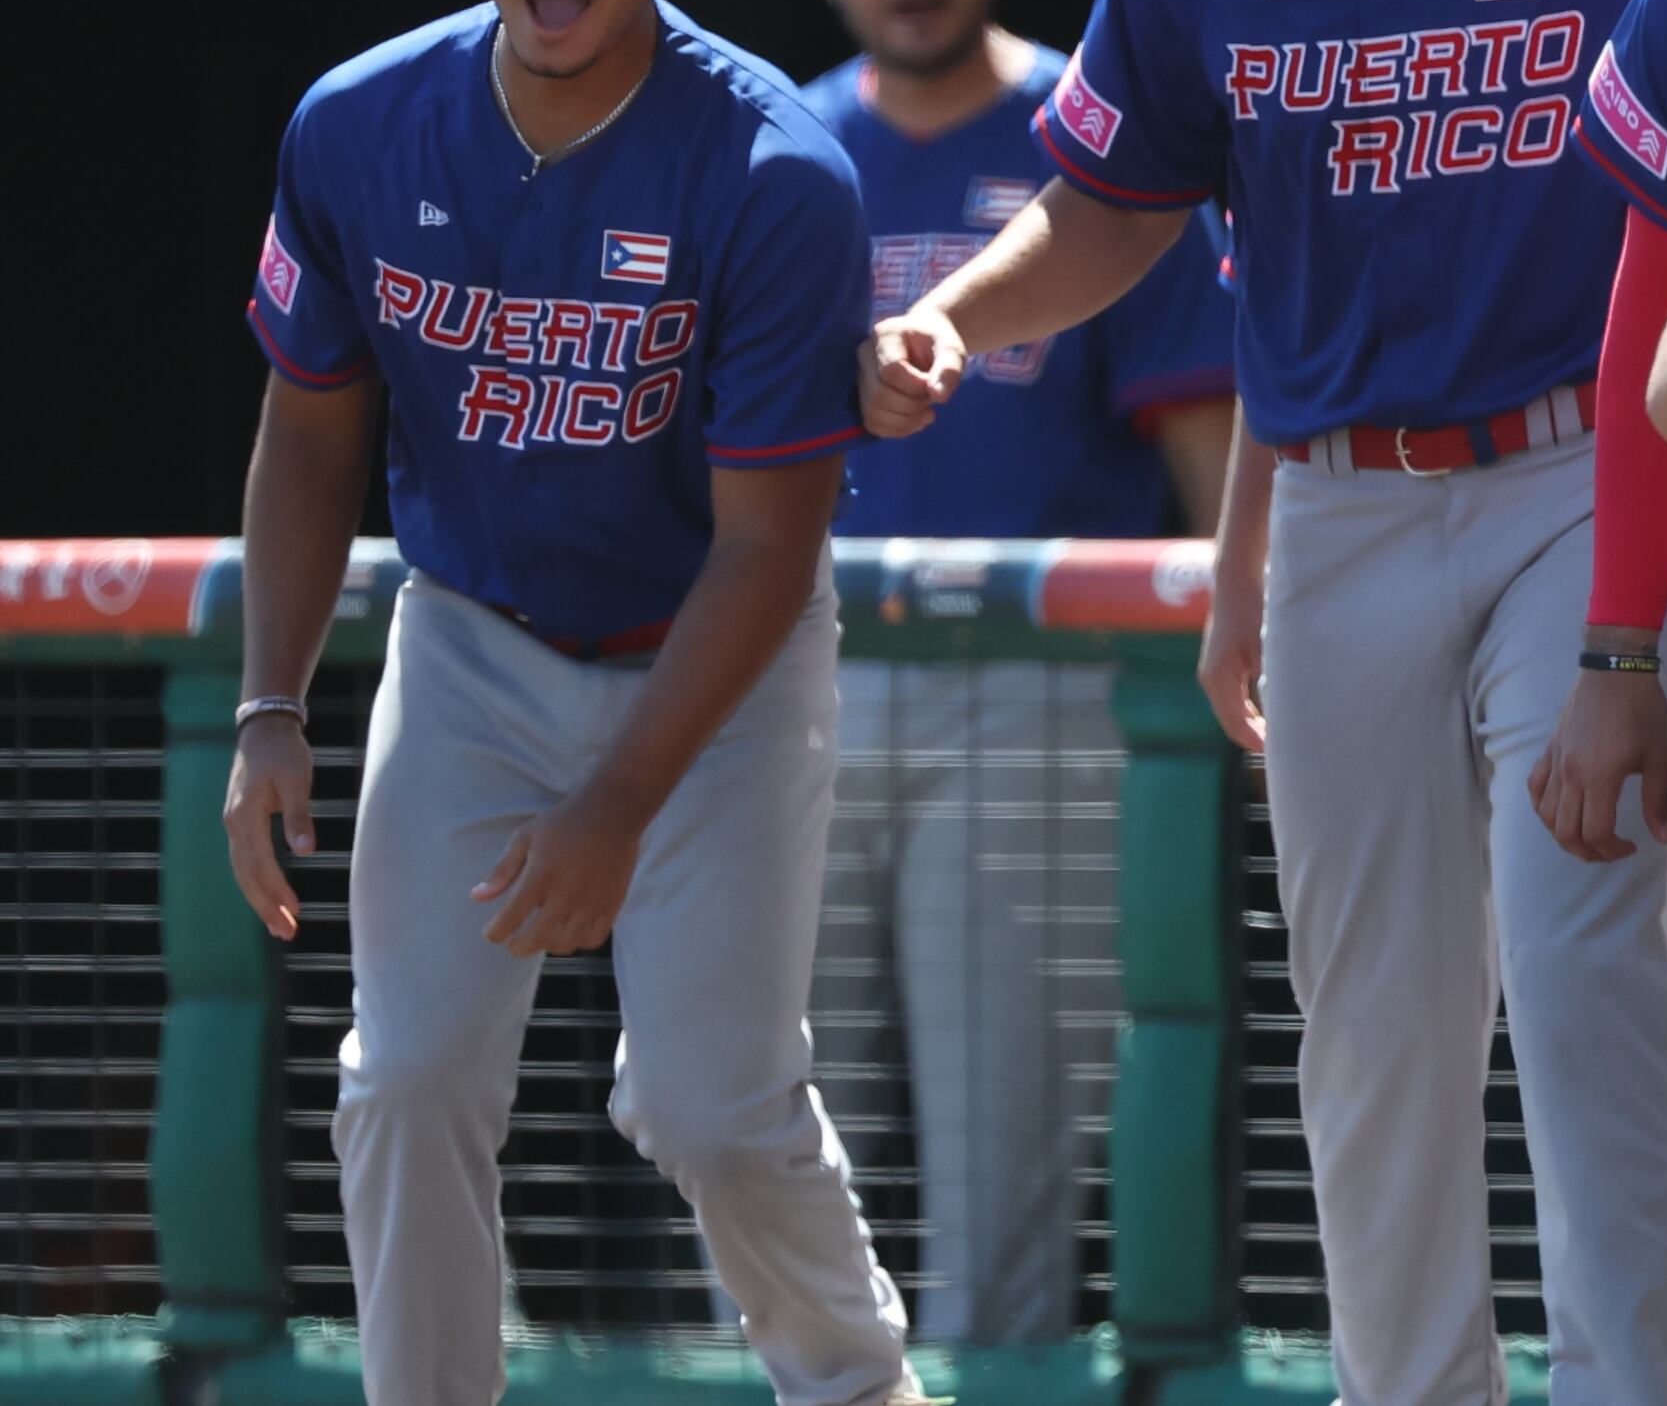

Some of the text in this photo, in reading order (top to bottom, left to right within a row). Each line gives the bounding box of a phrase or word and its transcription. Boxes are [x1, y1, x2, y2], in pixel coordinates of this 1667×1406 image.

[1226, 10, 1585, 119] PUERTO
[1328, 95, 1571, 195] RICO
[373, 256, 700, 373] PUERTO
[457, 364, 684, 450] RICO
